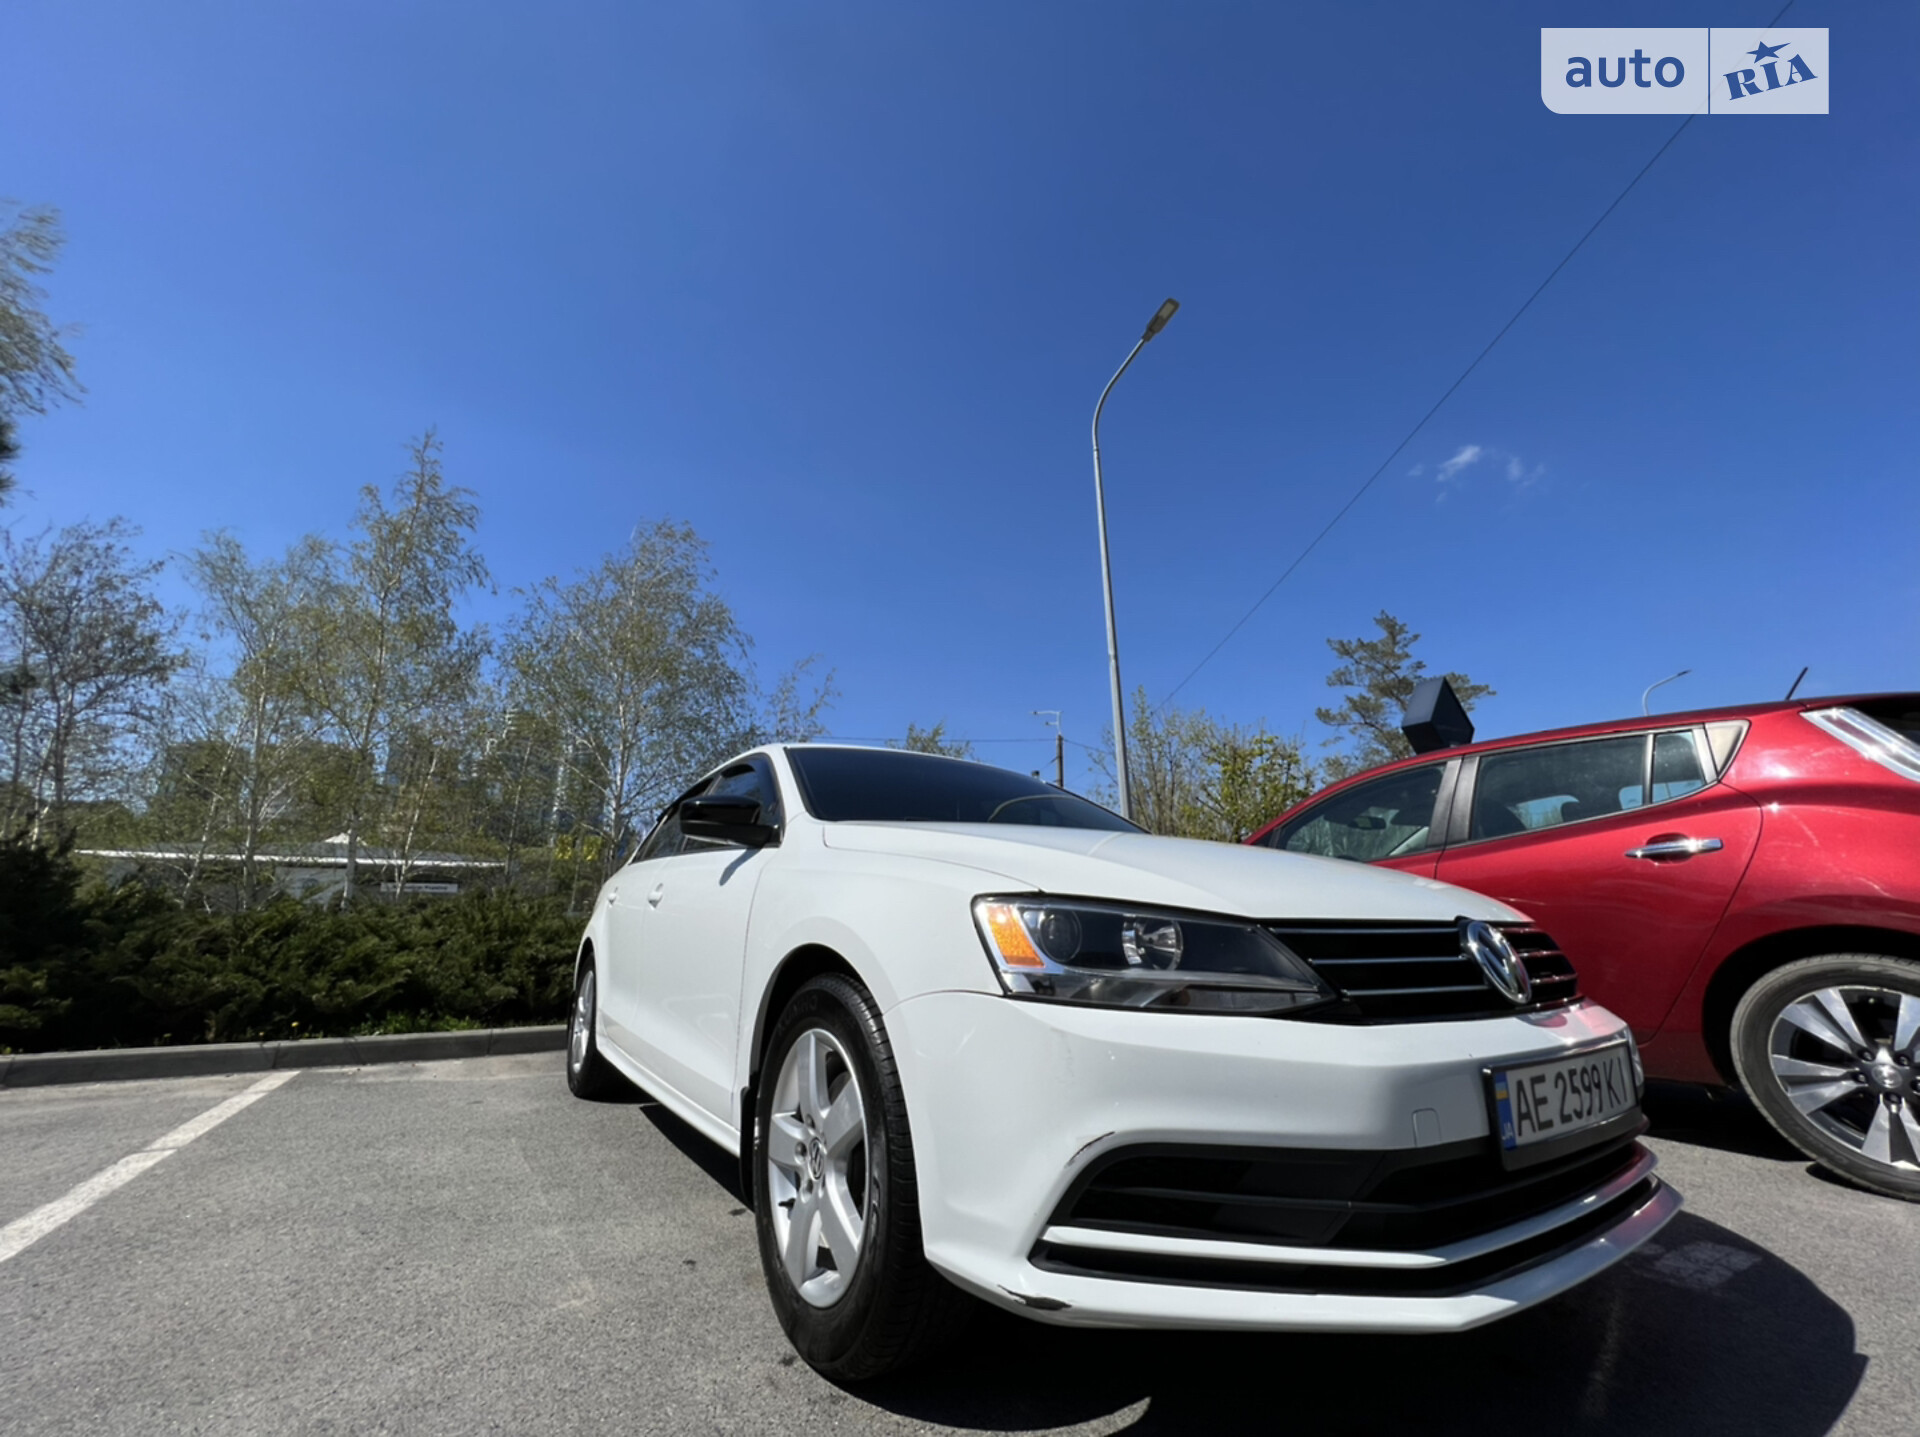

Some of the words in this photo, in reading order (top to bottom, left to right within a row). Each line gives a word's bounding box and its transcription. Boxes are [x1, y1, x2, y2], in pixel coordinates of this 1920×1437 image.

[1516, 1073, 1554, 1137] AE
[1554, 1063, 1604, 1124] 2599
[1603, 1056, 1628, 1109] KI
